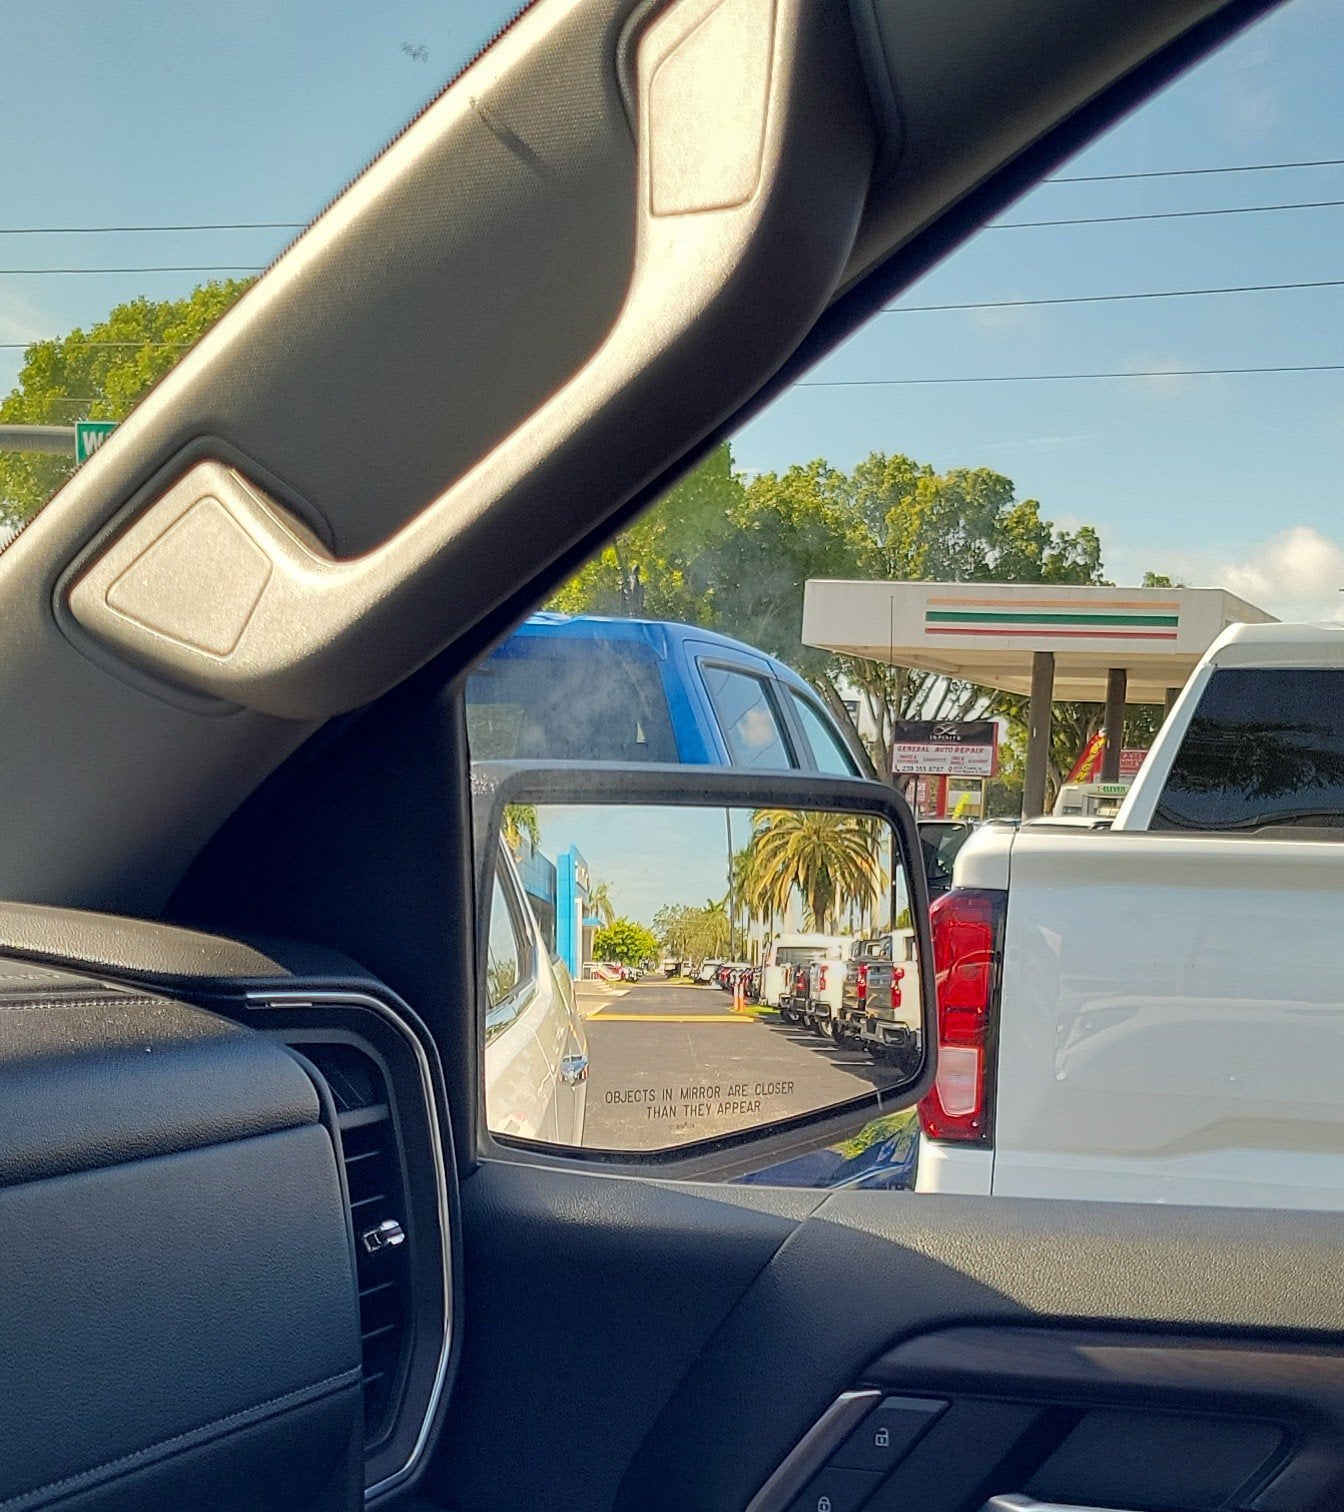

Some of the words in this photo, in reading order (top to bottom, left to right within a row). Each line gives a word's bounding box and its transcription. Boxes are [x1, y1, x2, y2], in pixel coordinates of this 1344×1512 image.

[896, 745, 930, 753] GENERAL
[605, 1088, 656, 1104] OBJECTS
[662, 1088, 673, 1101] IN
[680, 1085, 721, 1100] MIRROR
[727, 1084, 748, 1098] ARE
[754, 1081, 794, 1096] CLOSER
[647, 1105, 677, 1119] THAN
[684, 1103, 711, 1117] THEY
[716, 1100, 761, 1115] APPEAR
